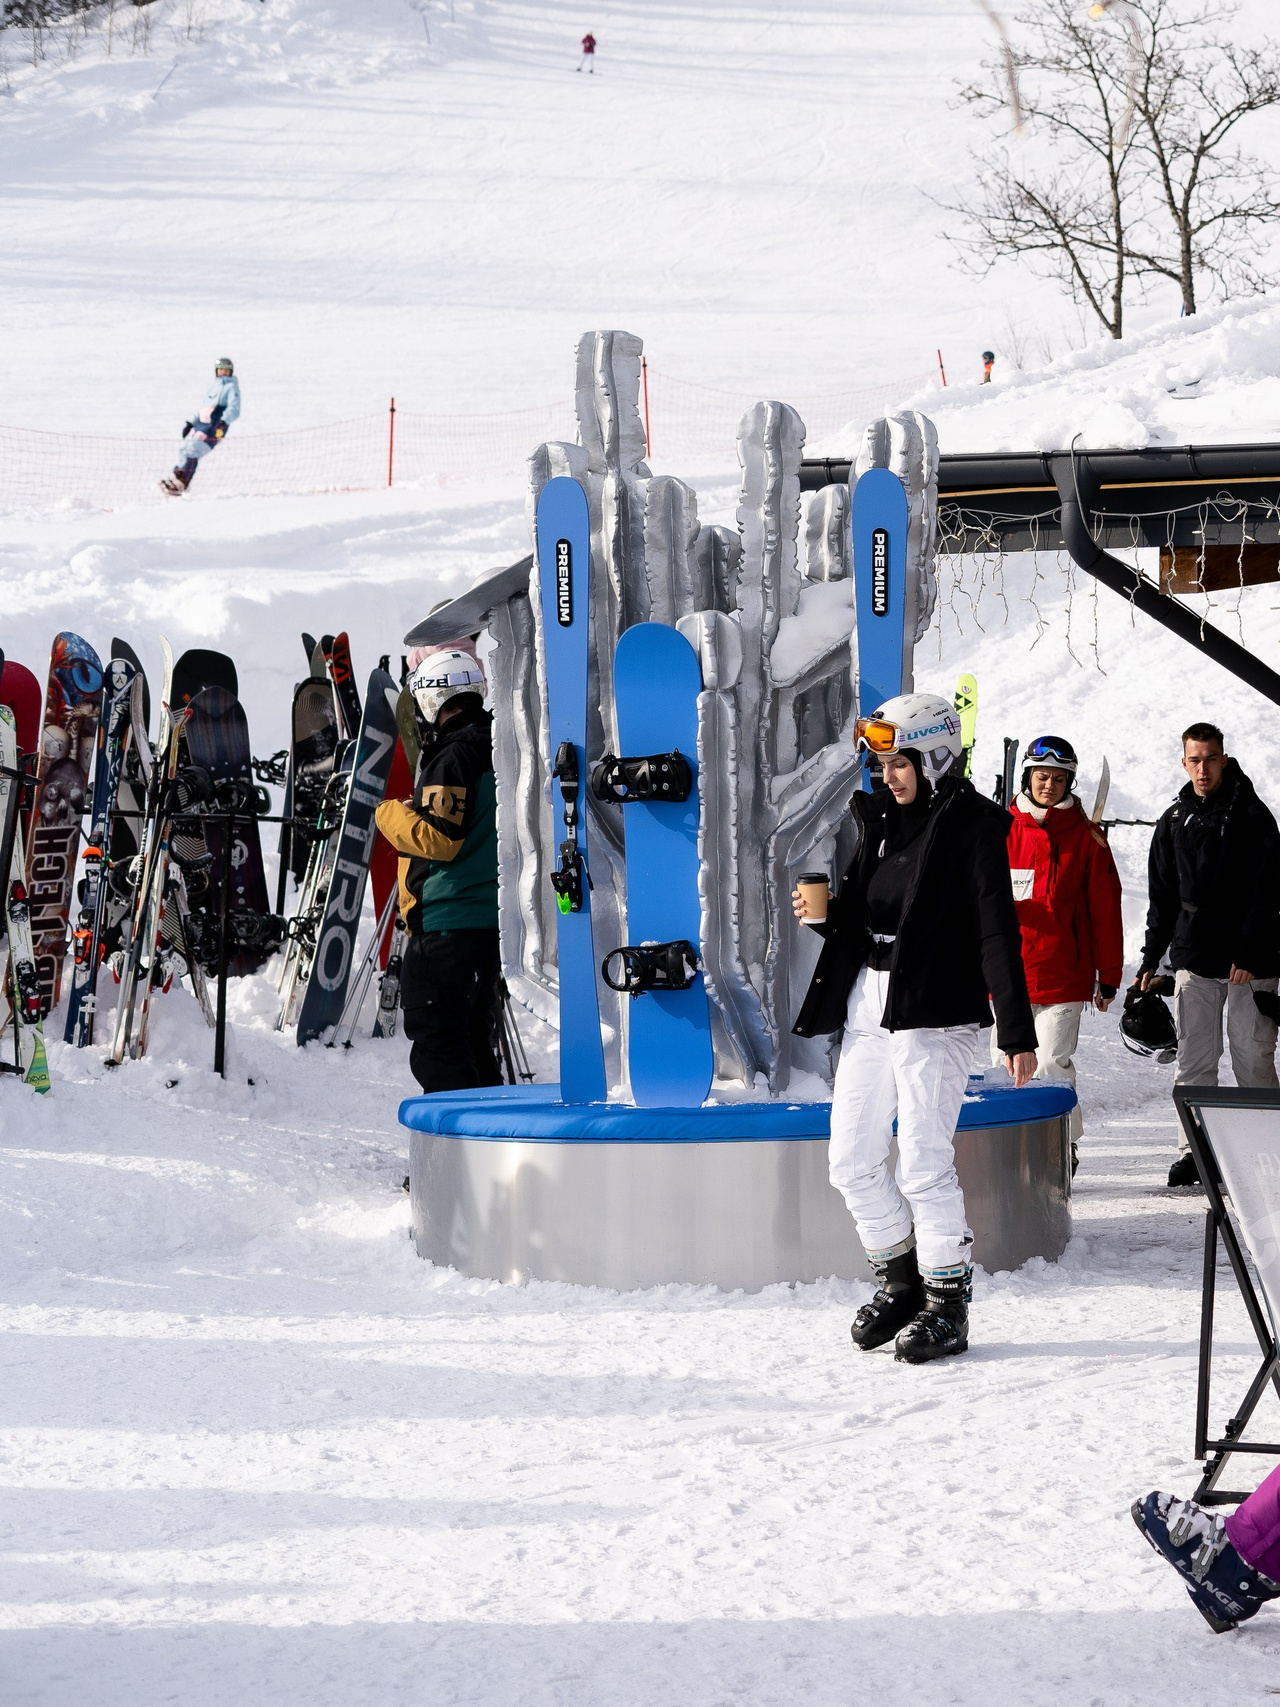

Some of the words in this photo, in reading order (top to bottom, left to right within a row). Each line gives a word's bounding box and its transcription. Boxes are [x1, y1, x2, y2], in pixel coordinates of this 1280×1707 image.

[558, 543, 571, 622] PREMIUM
[874, 533, 886, 612] PREMIUM
[907, 723, 948, 741] uvex
[317, 724, 394, 992] NITRO
[1174, 1559, 1245, 1614] LANGE
